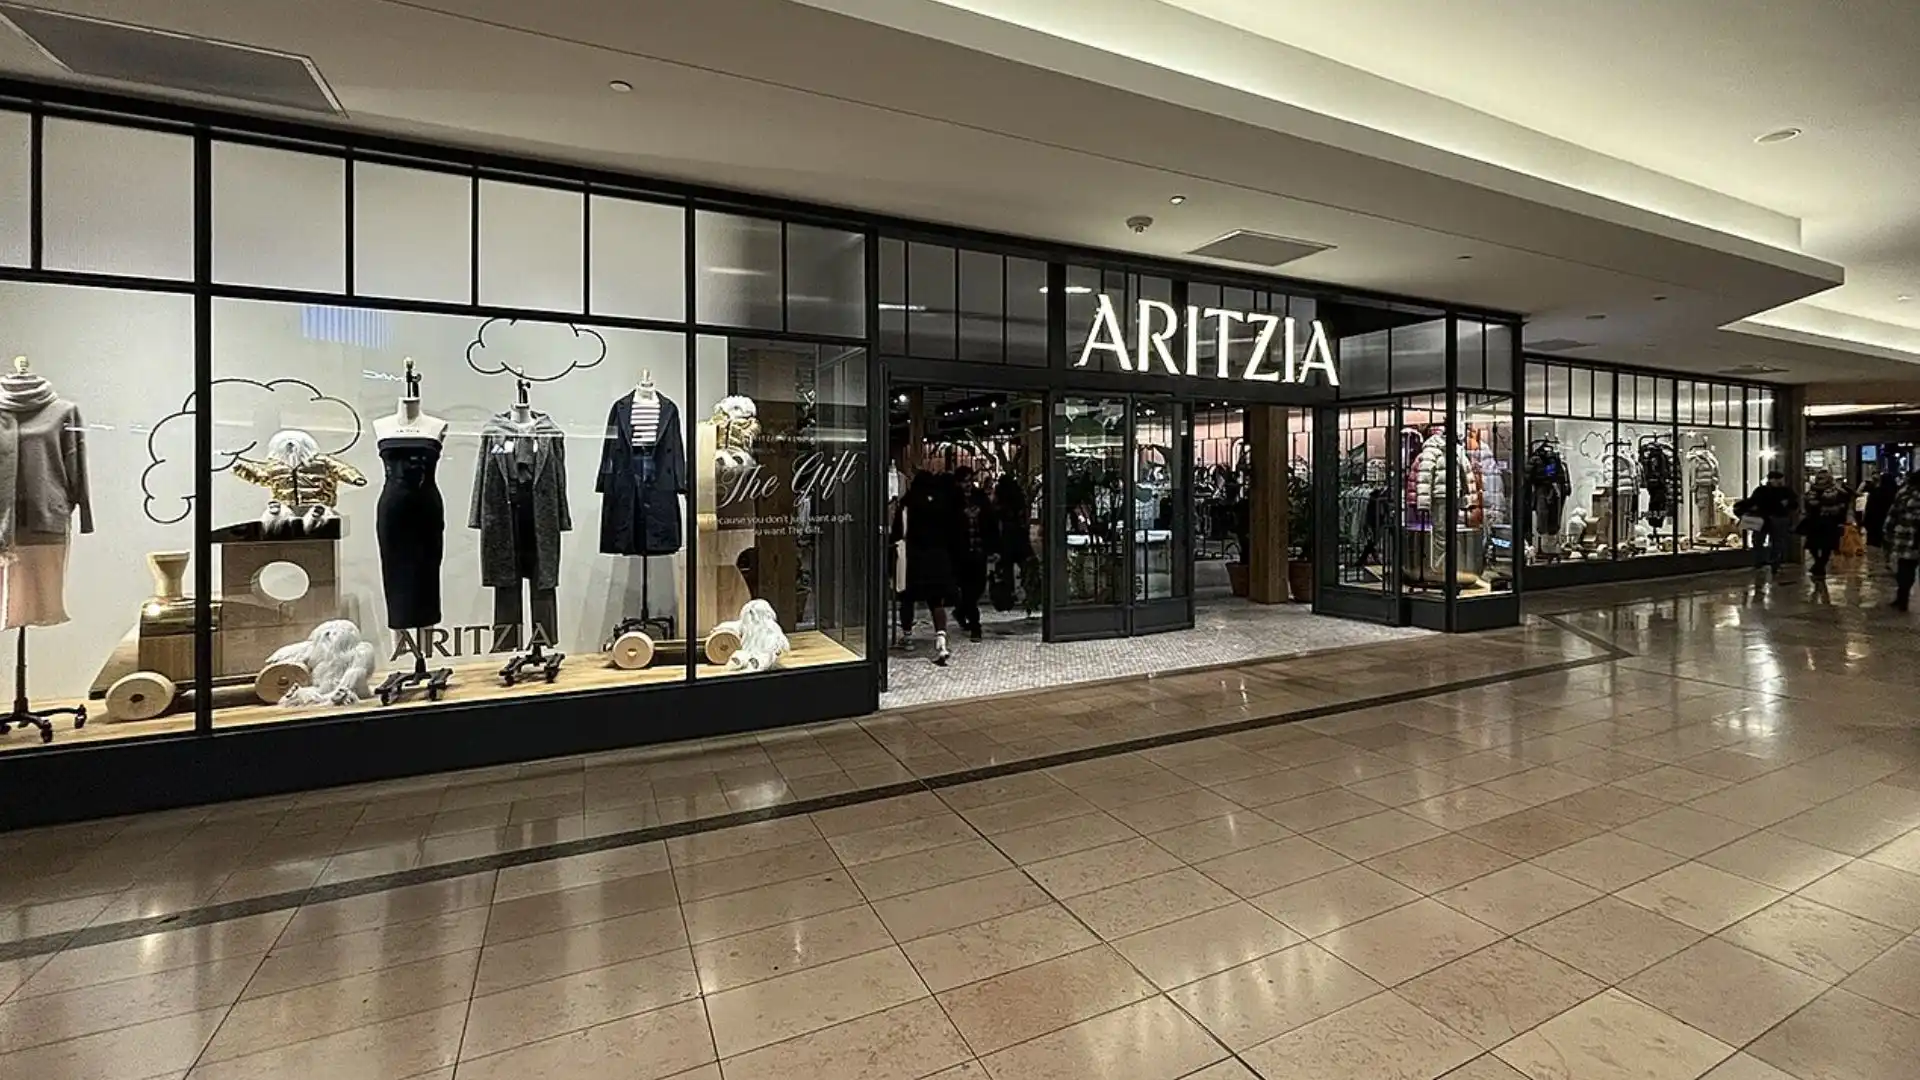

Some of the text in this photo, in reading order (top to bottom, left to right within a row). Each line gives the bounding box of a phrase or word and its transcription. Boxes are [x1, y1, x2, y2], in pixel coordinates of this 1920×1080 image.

[1073, 293, 1340, 387] ARITZIA
[717, 450, 863, 509] The Gift
[707, 515, 745, 526] cause
[746, 515, 764, 526] you
[765, 513, 788, 525] don't
[807, 513, 829, 524] want
[763, 524, 786, 535] want
[390, 622, 553, 661] ARITZIA
